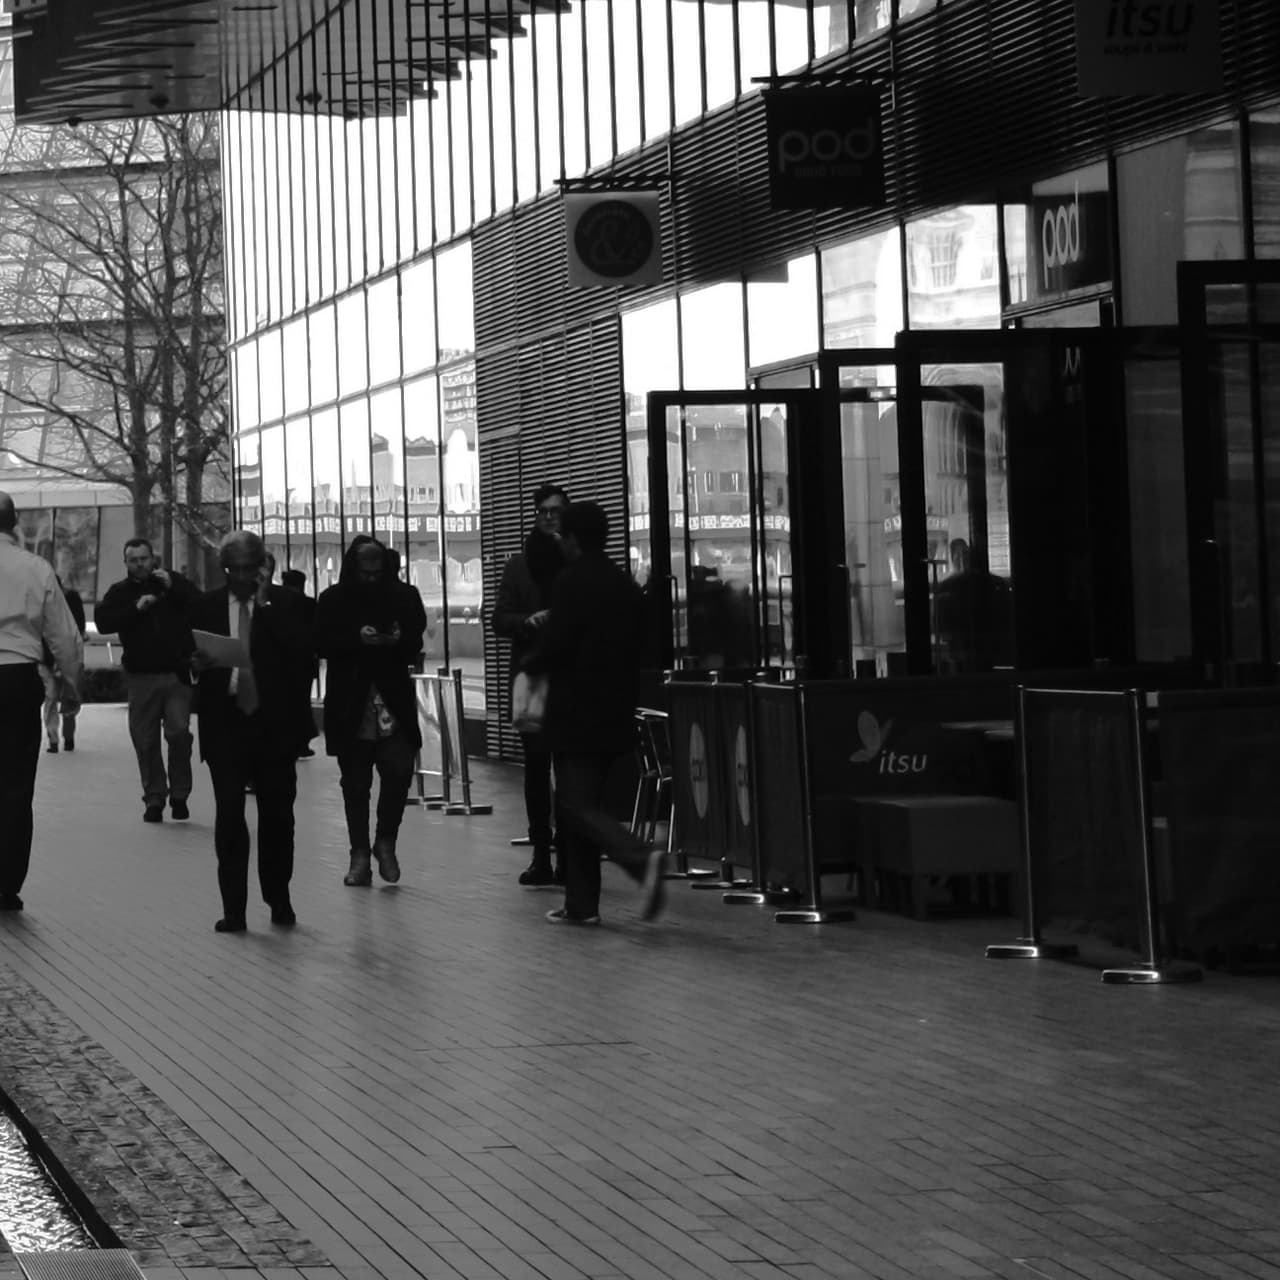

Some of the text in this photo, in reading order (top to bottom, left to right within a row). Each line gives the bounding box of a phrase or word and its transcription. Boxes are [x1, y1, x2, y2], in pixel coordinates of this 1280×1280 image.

[778, 117, 874, 173] pod
[1042, 179, 1080, 289] pod
[879, 749, 927, 774] itsu
